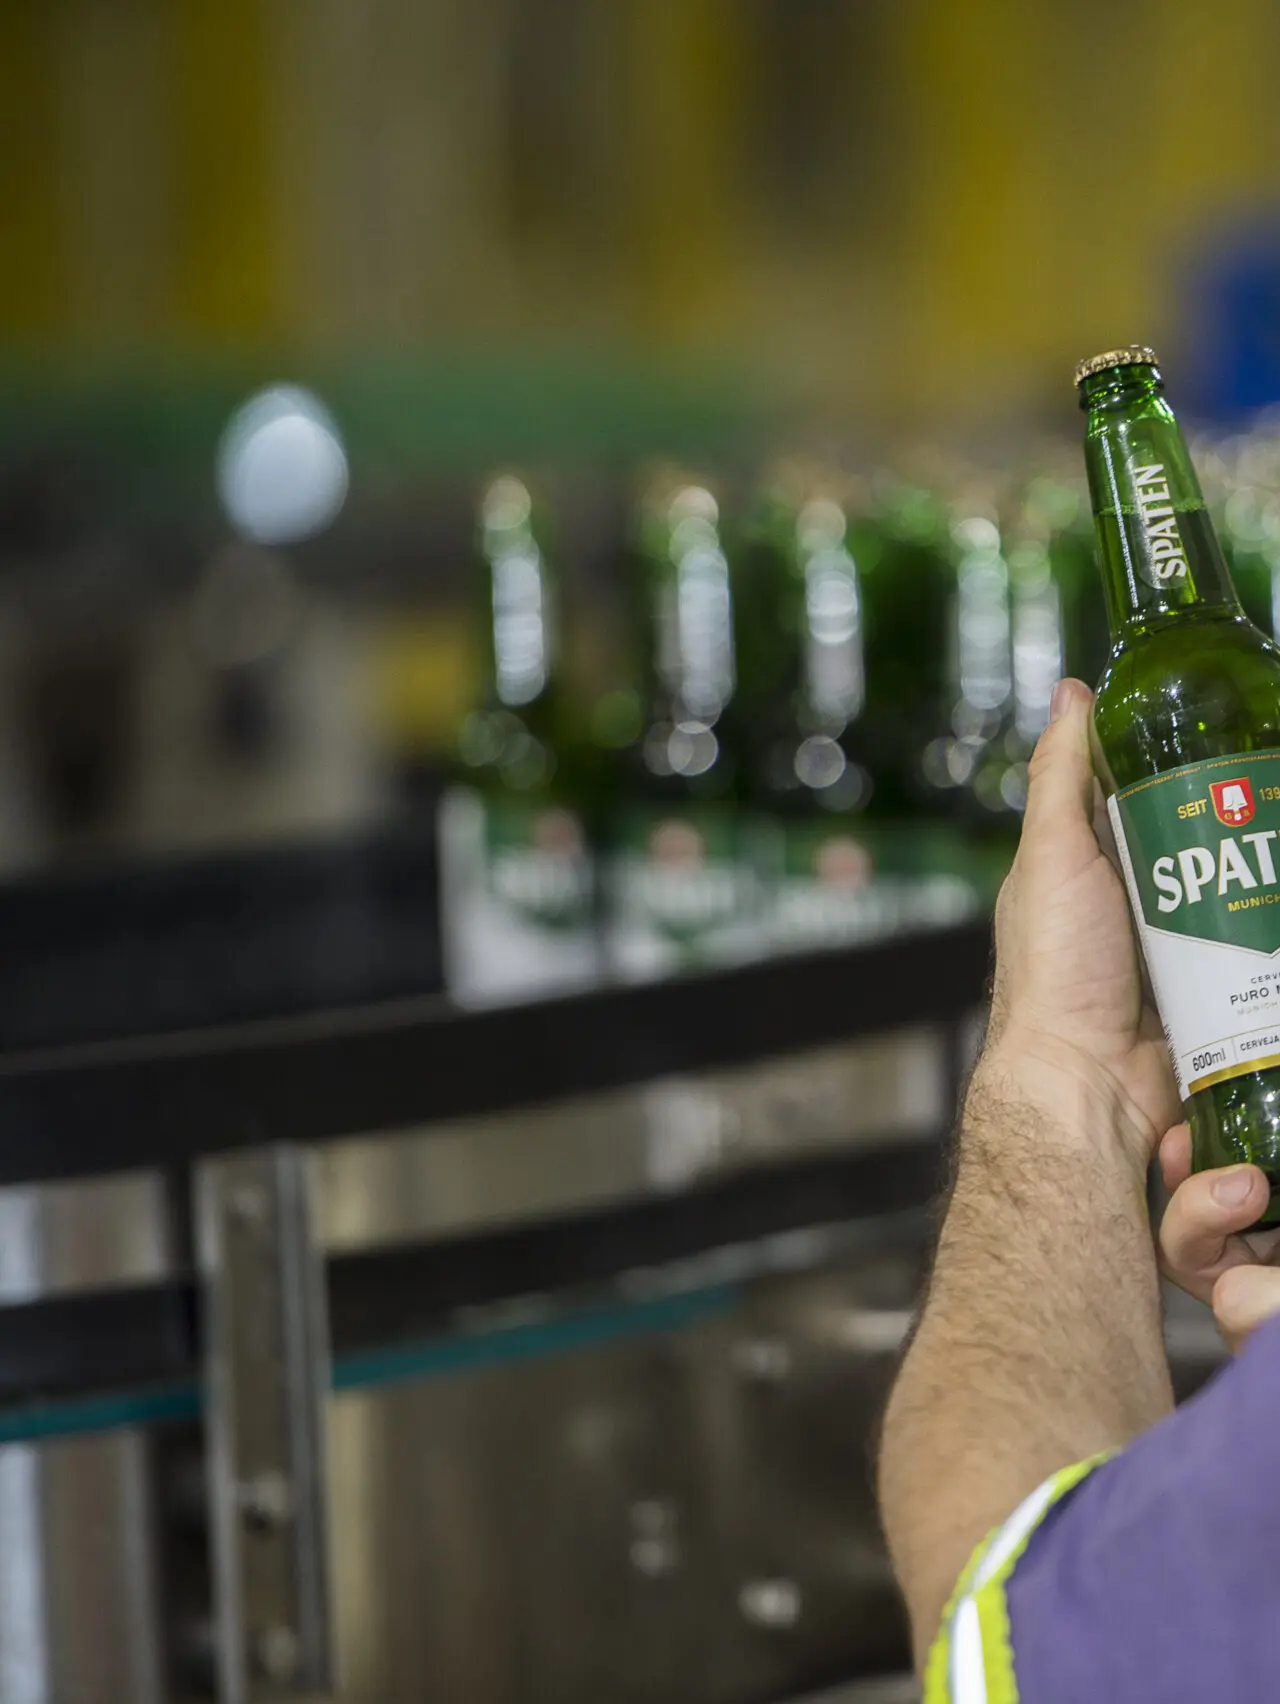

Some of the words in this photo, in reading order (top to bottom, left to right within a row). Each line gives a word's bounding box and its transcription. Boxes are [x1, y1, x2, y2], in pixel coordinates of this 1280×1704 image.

[1134, 463, 1187, 579] SPATEN
[1177, 798, 1207, 819] SEIT
[1230, 987, 1270, 1005] PURO
[1237, 1001, 1278, 1016] MUNICH
[1240, 1035, 1280, 1051] CERVEJA
[1192, 1048, 1226, 1071] 600ml
